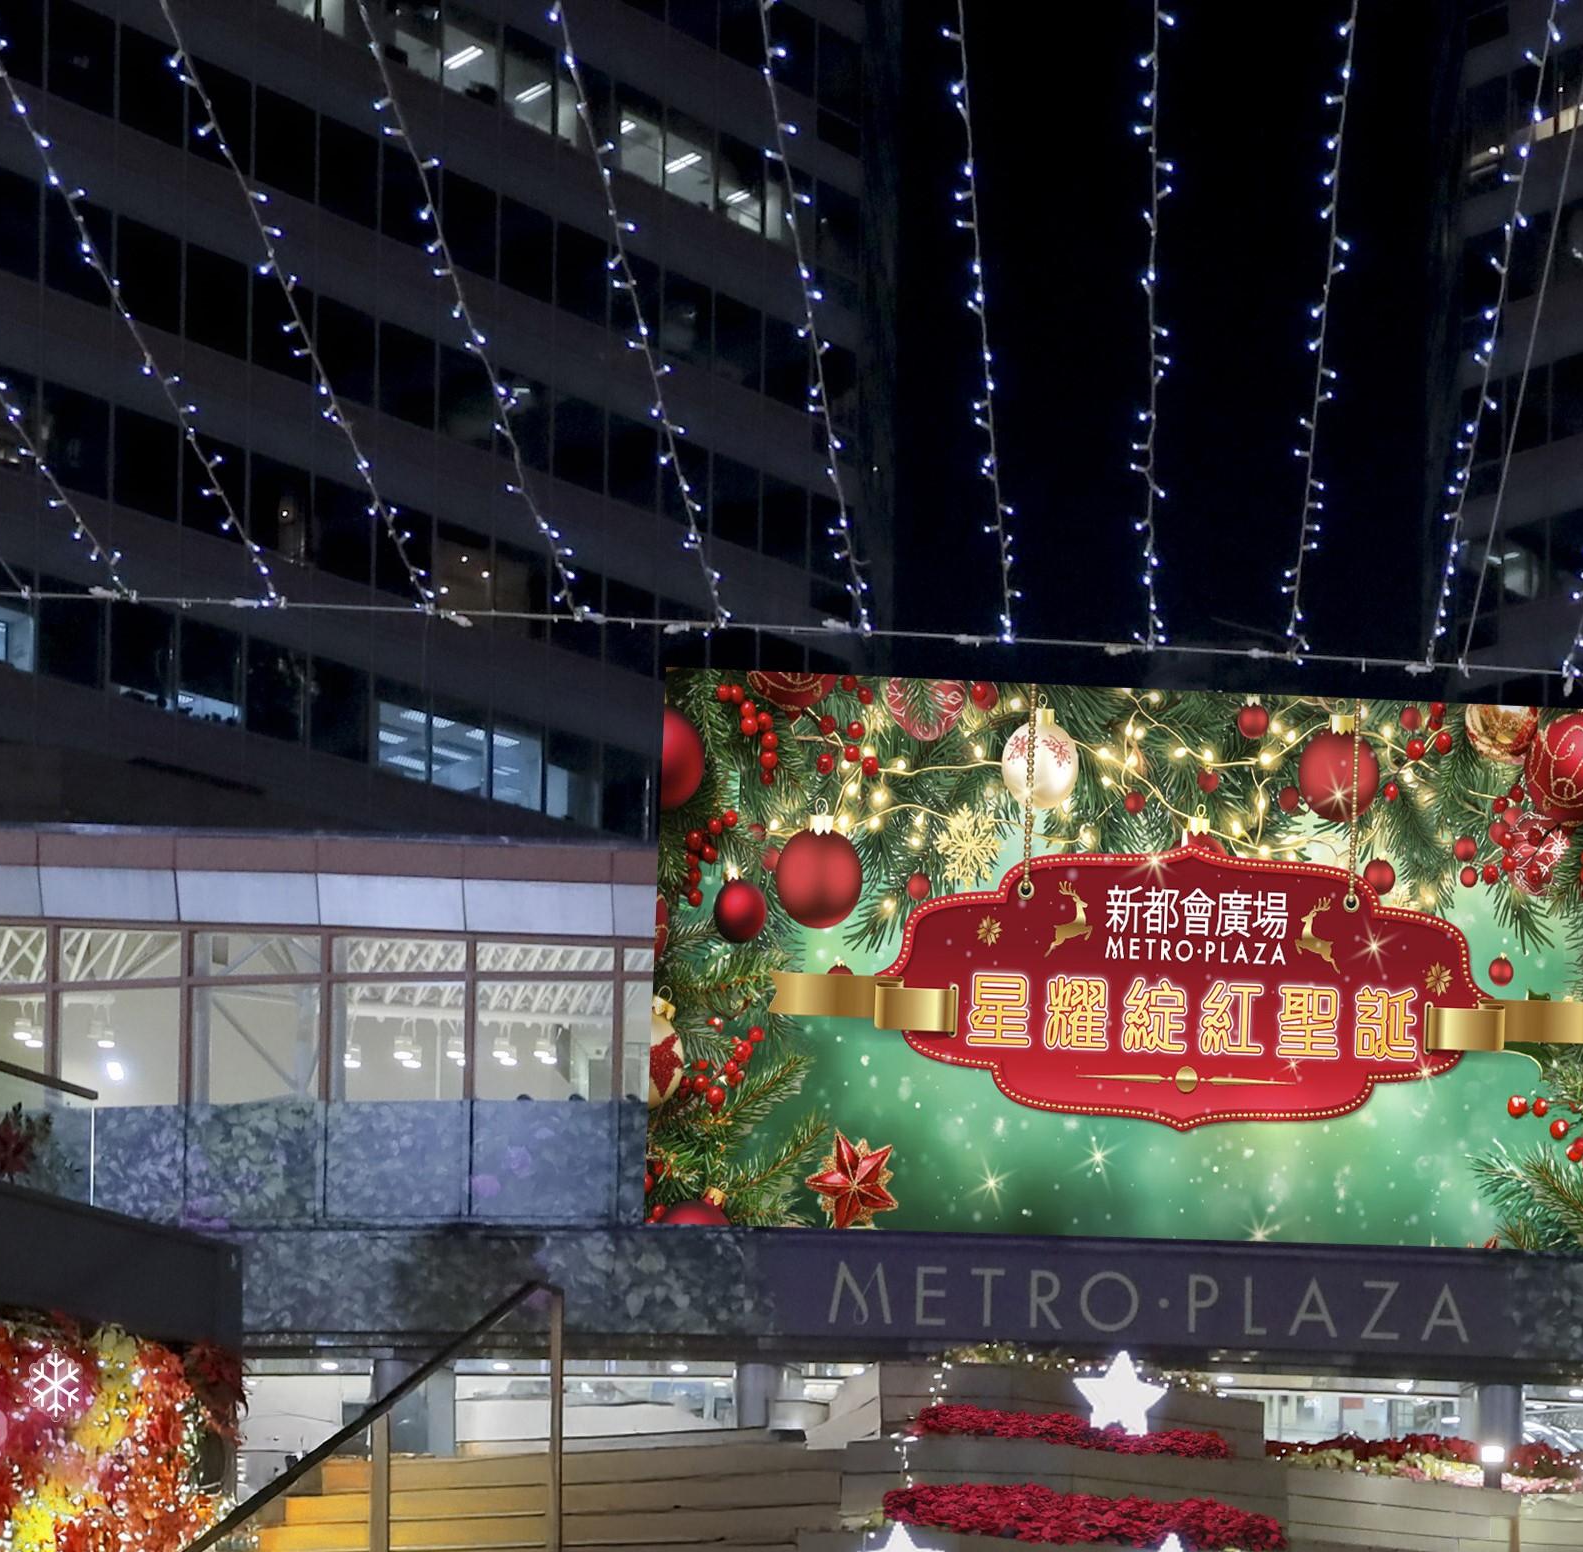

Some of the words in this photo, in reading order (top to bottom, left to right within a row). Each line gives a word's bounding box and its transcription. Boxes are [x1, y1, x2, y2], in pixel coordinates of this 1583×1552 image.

[1104, 884, 1289, 940] 新都會廣場
[965, 971, 1419, 1062] 星耀綻紅聖誕
